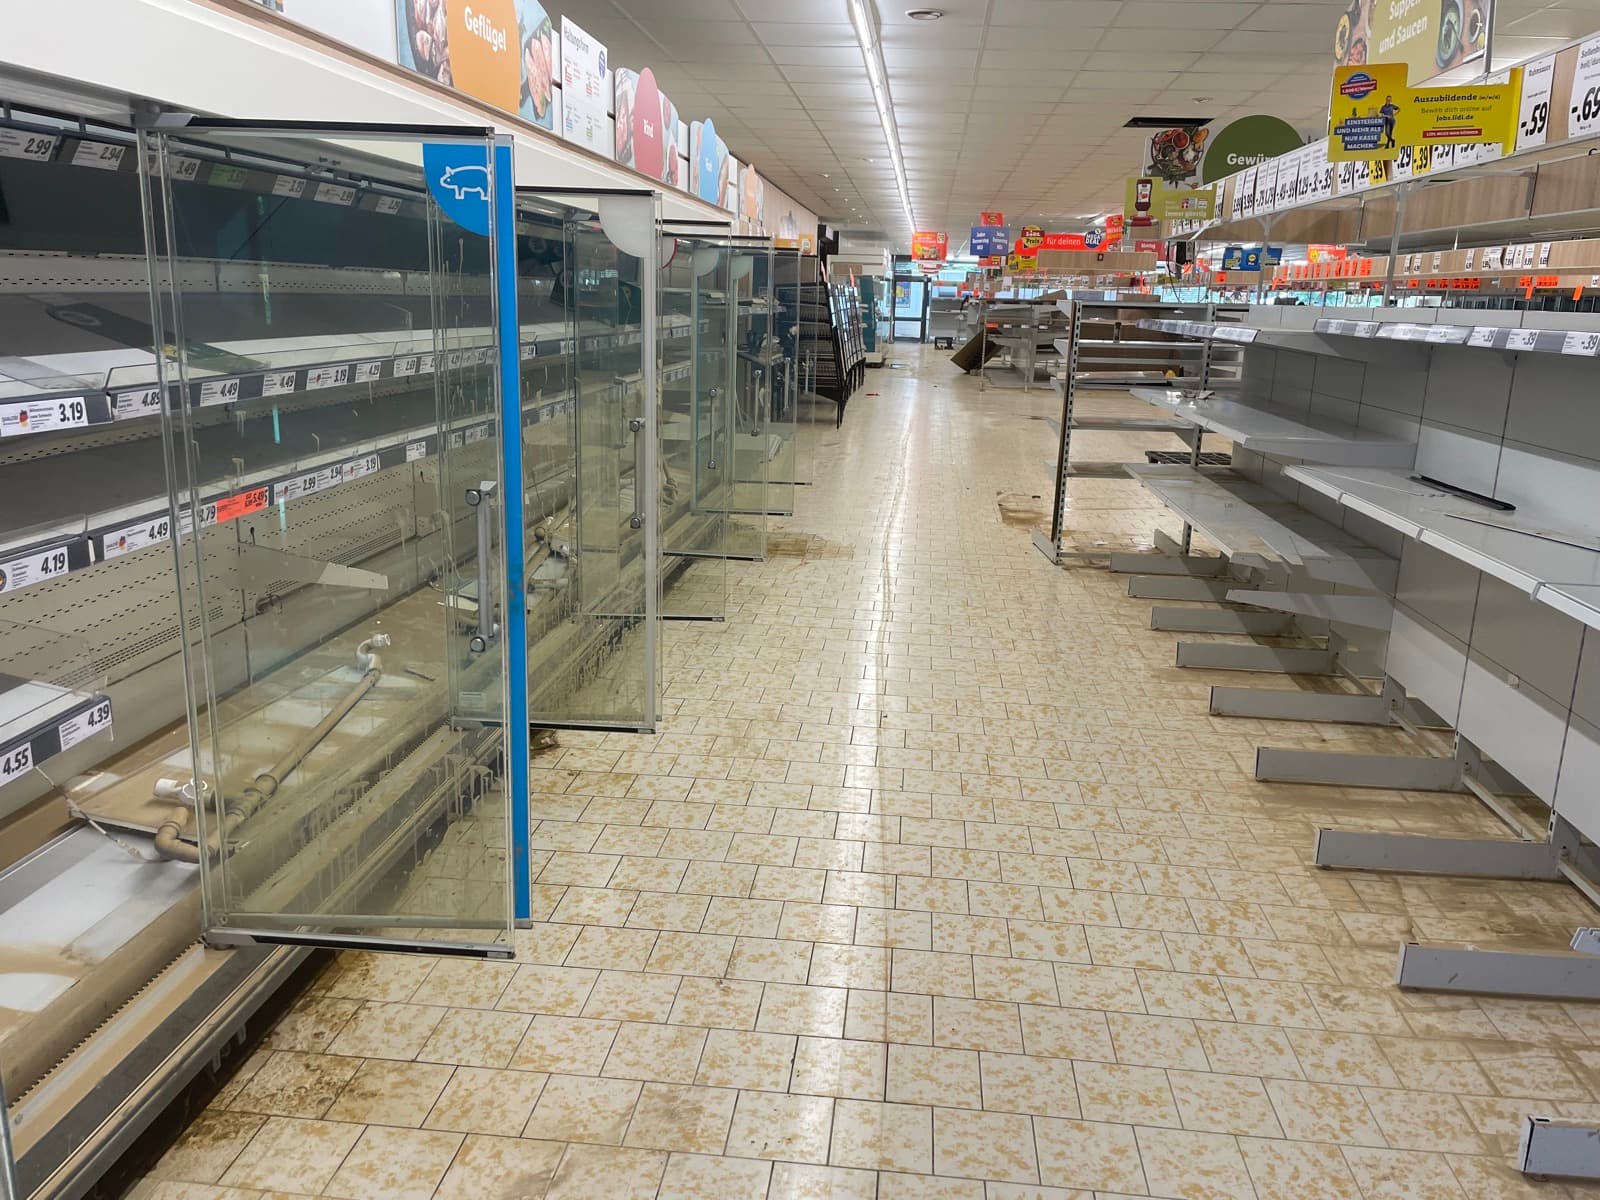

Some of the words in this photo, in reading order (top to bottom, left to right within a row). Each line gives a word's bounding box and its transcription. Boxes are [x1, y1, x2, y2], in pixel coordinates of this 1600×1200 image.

[464, 5, 507, 53] Geflügel
[1379, 28, 1396, 54] und
[1396, 16, 1428, 45] Saucen
[1413, 93, 1477, 103] Auszubildende
[1436, 114, 1474, 122] jobs.lidl.de
[1520, 101, 1547, 136] -.59
[23, 137, 52, 156] 2.99
[1413, 147, 1428, 170] -.39
[1046, 237, 1056, 245] für
[1057, 237, 1081, 245] deinen
[1581, 334, 1599, 350] -.39
[220, 382, 238, 398] 4.49
[58, 401, 84, 422] 3.19
[366, 457, 377, 472] 3.19
[303, 476, 316, 491] 2.99
[148, 521, 168, 540] 4.49
[41, 552, 66, 574] 4.19
[87, 703, 110, 727] 4.39
[2, 747, 29, 775] 4.55
